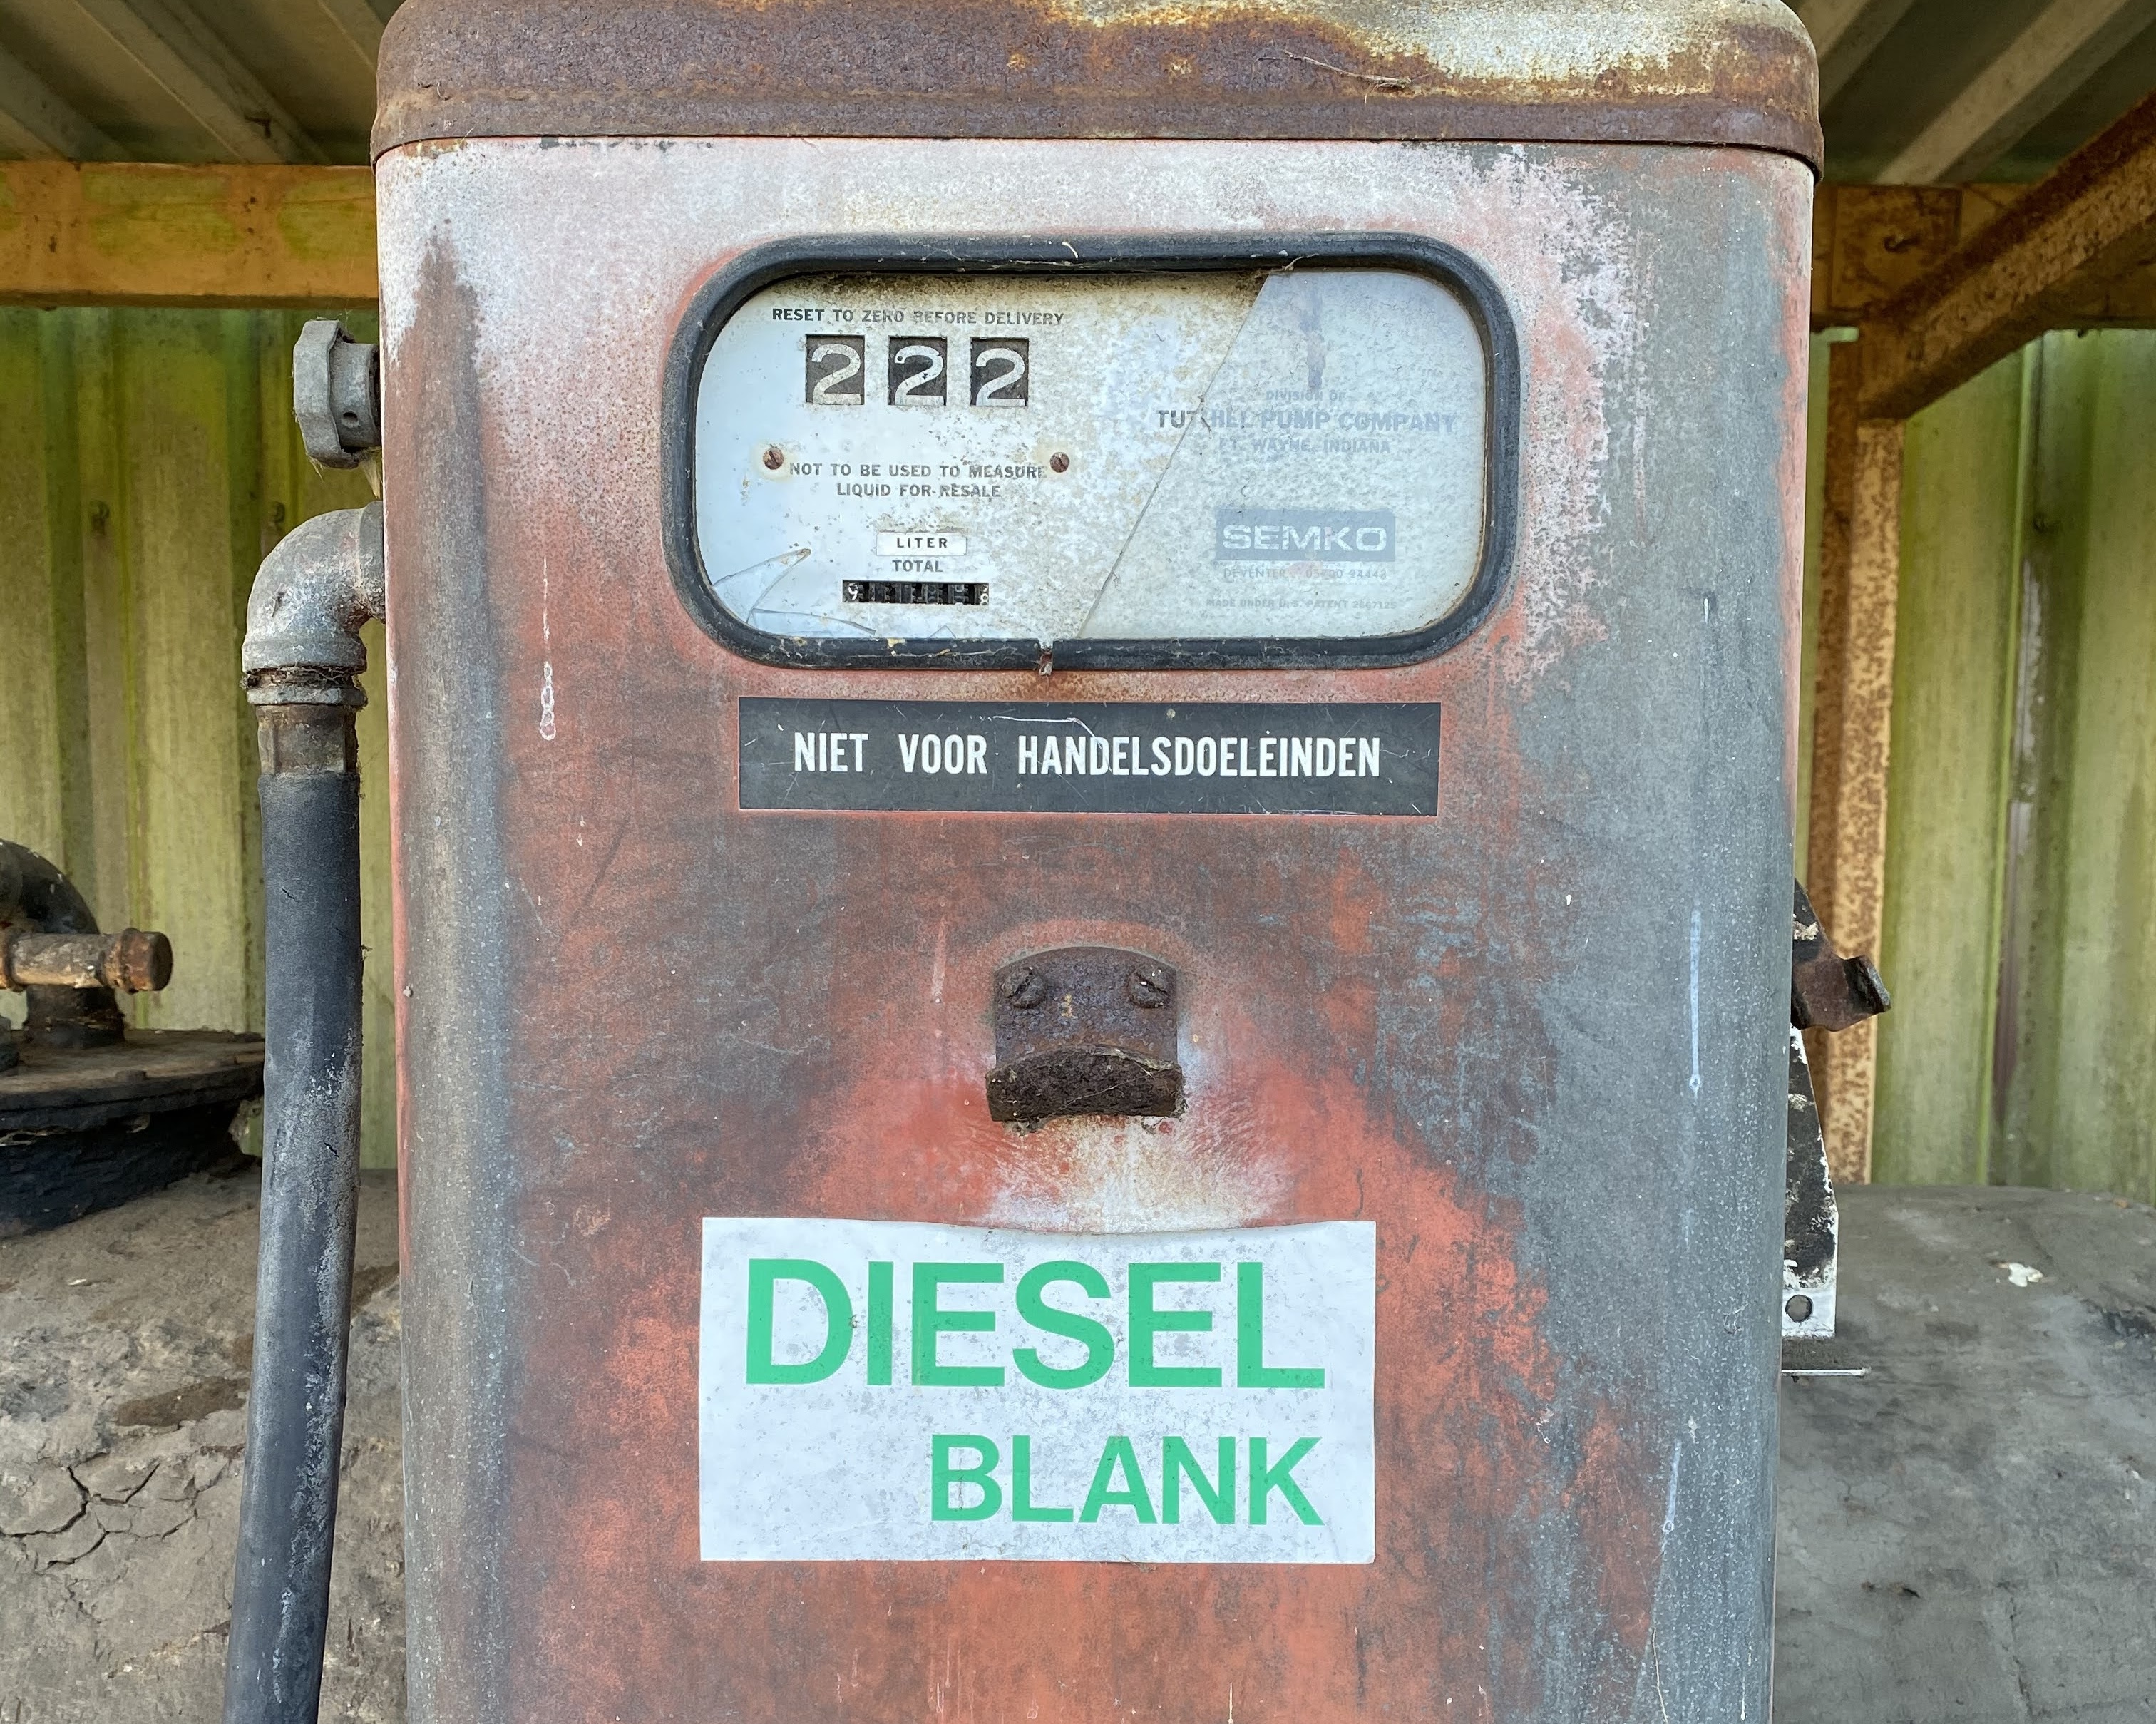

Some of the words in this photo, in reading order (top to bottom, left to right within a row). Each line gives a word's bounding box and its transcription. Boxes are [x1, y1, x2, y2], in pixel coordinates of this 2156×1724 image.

[772, 308, 825, 322] RESET
[832, 309, 854, 322] TO
[861, 309, 905, 323] ZERO
[913, 311, 977, 324] BEFORE
[985, 312, 1065, 326] DELIVERY
[1261, 409, 1330, 429] PUMP
[1338, 411, 1458, 433] COMPANY
[1323, 439, 1391, 454] INDIANA
[789, 462, 823, 476] NOT
[830, 463, 852, 477] TO
[860, 463, 881, 477] BE
[888, 464, 932, 478] USED
[939, 465, 961, 478] TO
[968, 465, 1047, 479] MEASURE
[836, 483, 891, 498] LIQUID
[900, 484, 933, 497] FOR
[940, 485, 1001, 498] RESALE
[896, 537, 948, 549] LITER
[1222, 524, 1387, 551] SEMKO
[891, 560, 944, 573] TOTAL
[1223, 568, 1285, 579] DEVENTER
[794, 732, 868, 773] NIET
[898, 734, 987, 774] VOOR
[1017, 735, 1380, 778] HANDELSDOELEINDEN
[745, 1258, 1325, 1390] DIESEL
[931, 1433, 1325, 1526] BLANK
